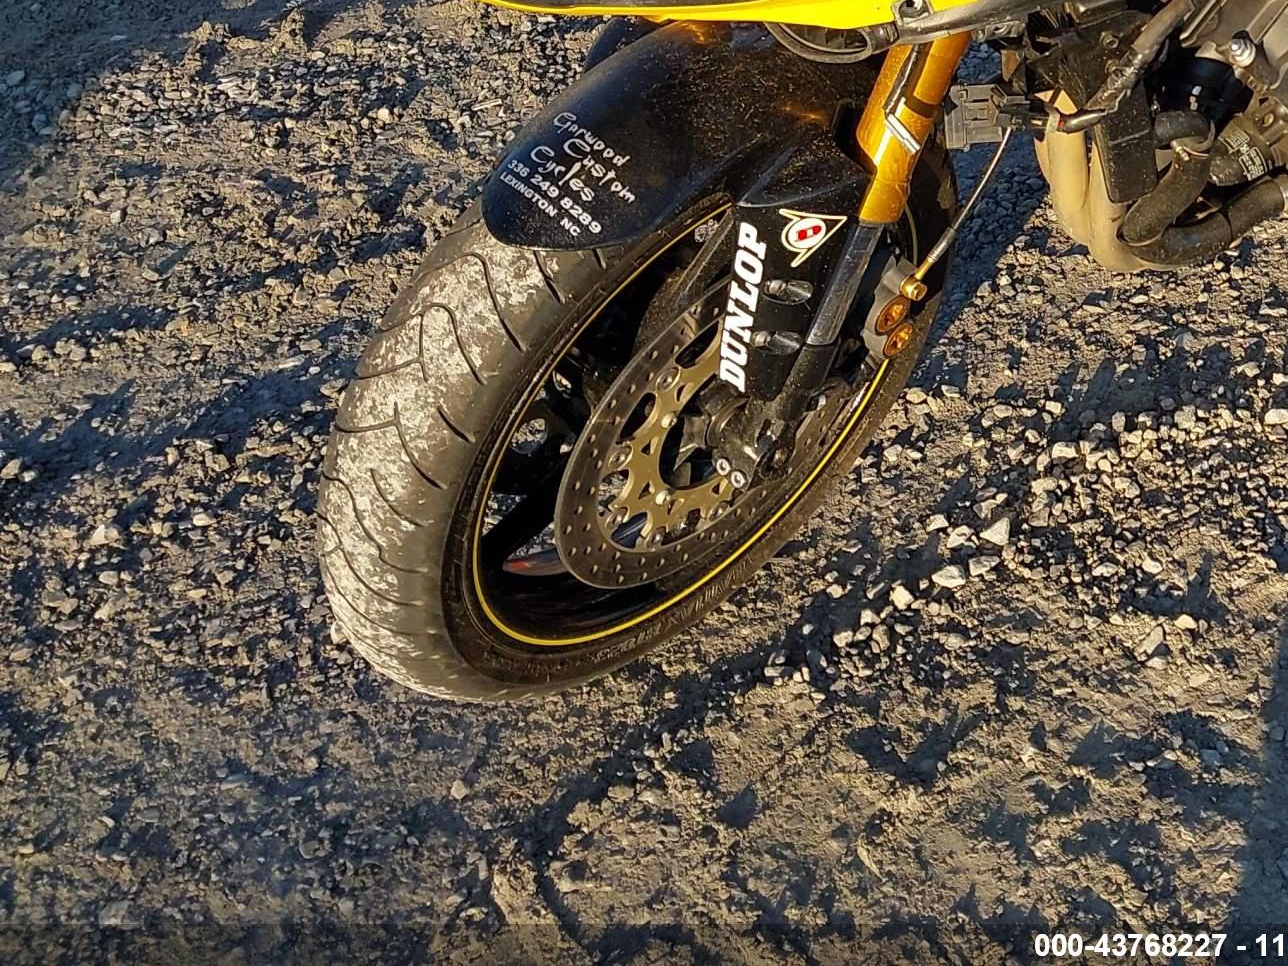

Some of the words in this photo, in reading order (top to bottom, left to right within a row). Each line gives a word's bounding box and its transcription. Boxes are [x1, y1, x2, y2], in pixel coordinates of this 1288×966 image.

[553, 111, 631, 167] Garwood
[562, 138, 636, 204] Custom
[499, 171, 558, 218] LEXINGTON
[559, 217, 581, 237] NC
[507, 159, 531, 178] 336
[529, 174, 560, 199] 249
[559, 196, 602, 234] 8289
[530, 145, 595, 202] Cycles
[719, 221, 768, 394] DUNLOP
